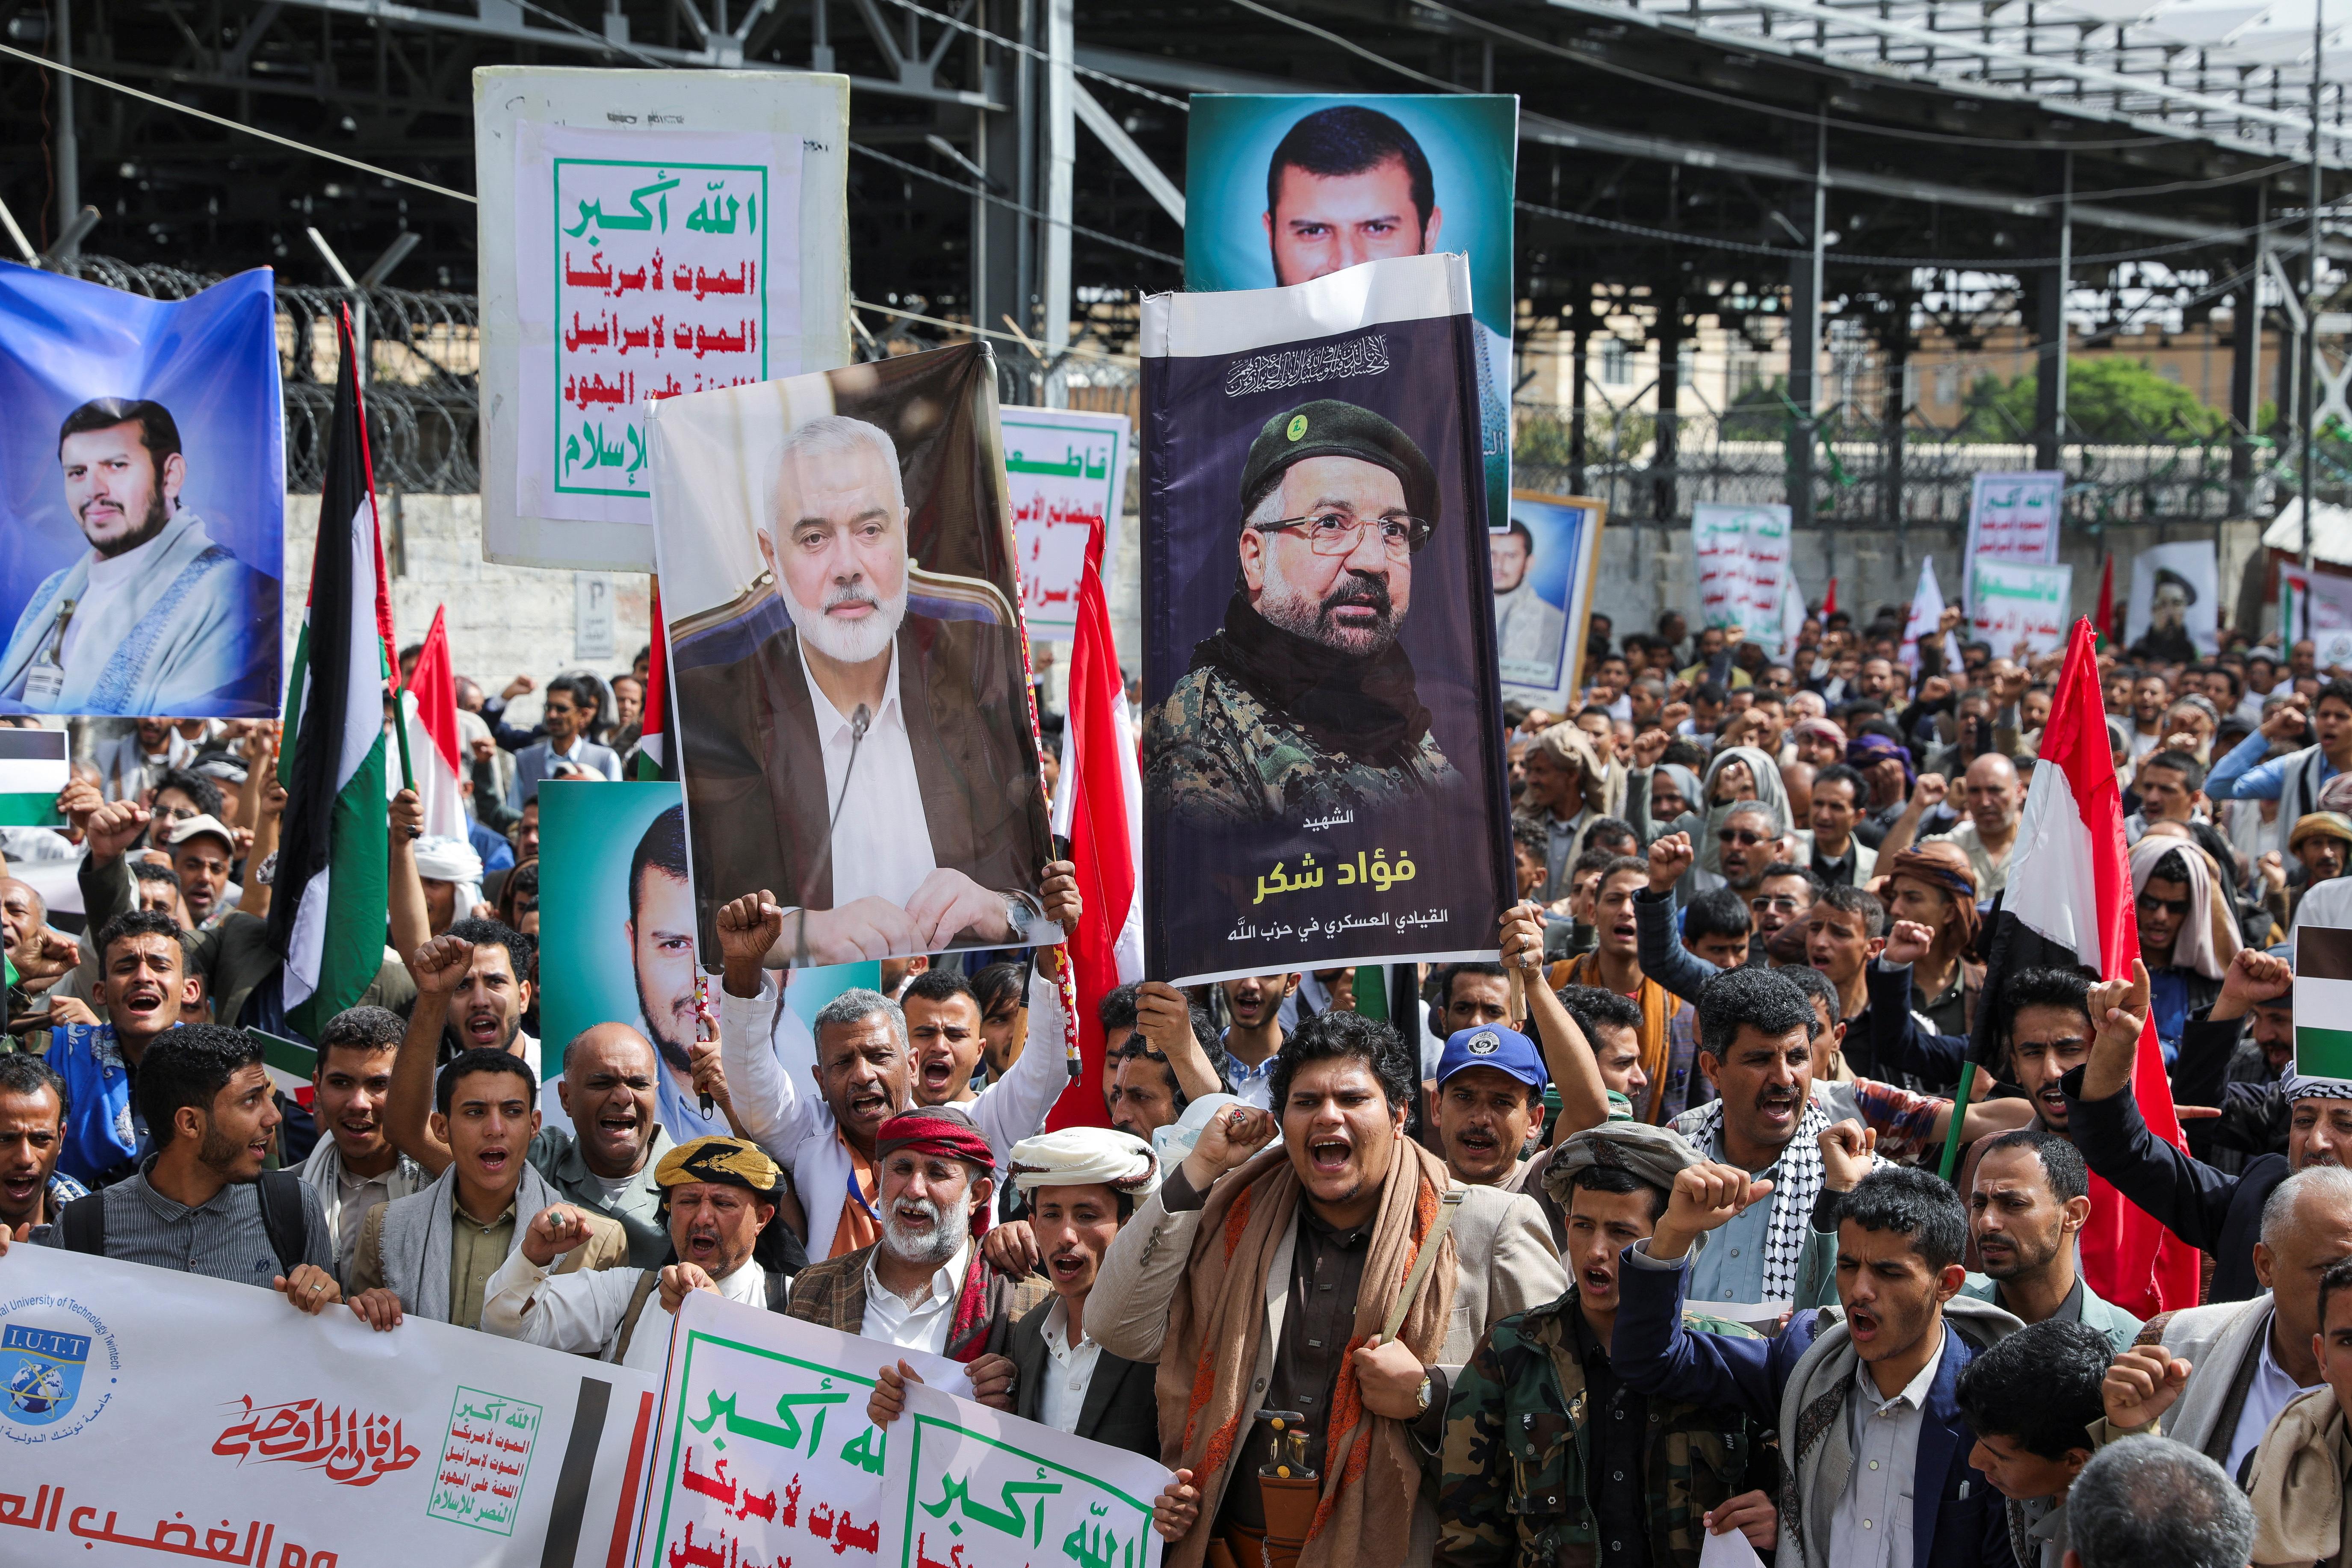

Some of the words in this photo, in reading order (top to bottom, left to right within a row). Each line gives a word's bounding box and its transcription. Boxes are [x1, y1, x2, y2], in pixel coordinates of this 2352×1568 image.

[562, 170, 681, 247] أكبر
[686, 180, 756, 236] الله
[565, 246, 664, 298] لأمريكا
[673, 259, 756, 302] الموت
[565, 308, 665, 359] لإسرائيل
[673, 318, 756, 360] الموت
[564, 369, 634, 413] اليهود
[1303, 807, 1353, 832] الشهيد
[1253, 852, 1324, 904] شكر
[1337, 848, 1416, 892] فؤاد
[1227, 916, 1256, 941] الله
[1261, 921, 1292, 942] حزب
[1298, 916, 1319, 942] في
[1325, 912, 1390, 939] العسكري
[1395, 908, 1448, 934] القيادي
[9, 1294, 56, 1310] University
[57, 1297, 68, 1307] of
[68, 1299, 109, 1336] Technology
[103, 1334, 122, 1370] Twintech
[9, 1329, 86, 1356] I.U.T.T
[82, 1392, 112, 1424] جامعة
[455, 1398, 508, 1423] أكبر
[505, 1406, 537, 1431] الله
[687, 1377, 850, 1460] أكبر
[5, 1427, 47, 1444] الدولية
[495, 1436, 531, 1455] الموت
[439, 1469, 471, 1488] اليهود
[489, 1458, 525, 1477] الموت
[471, 1477, 489, 1493] على
[491, 1479, 519, 1500] اللعنة
[682, 1446, 802, 1529] لأمريكا
[432, 1489, 476, 1519] للإسلام
[473, 1501, 513, 1524] النصر
[918, 1467, 1064, 1550] أكبر
[68, 1505, 275, 1568] الغضب
